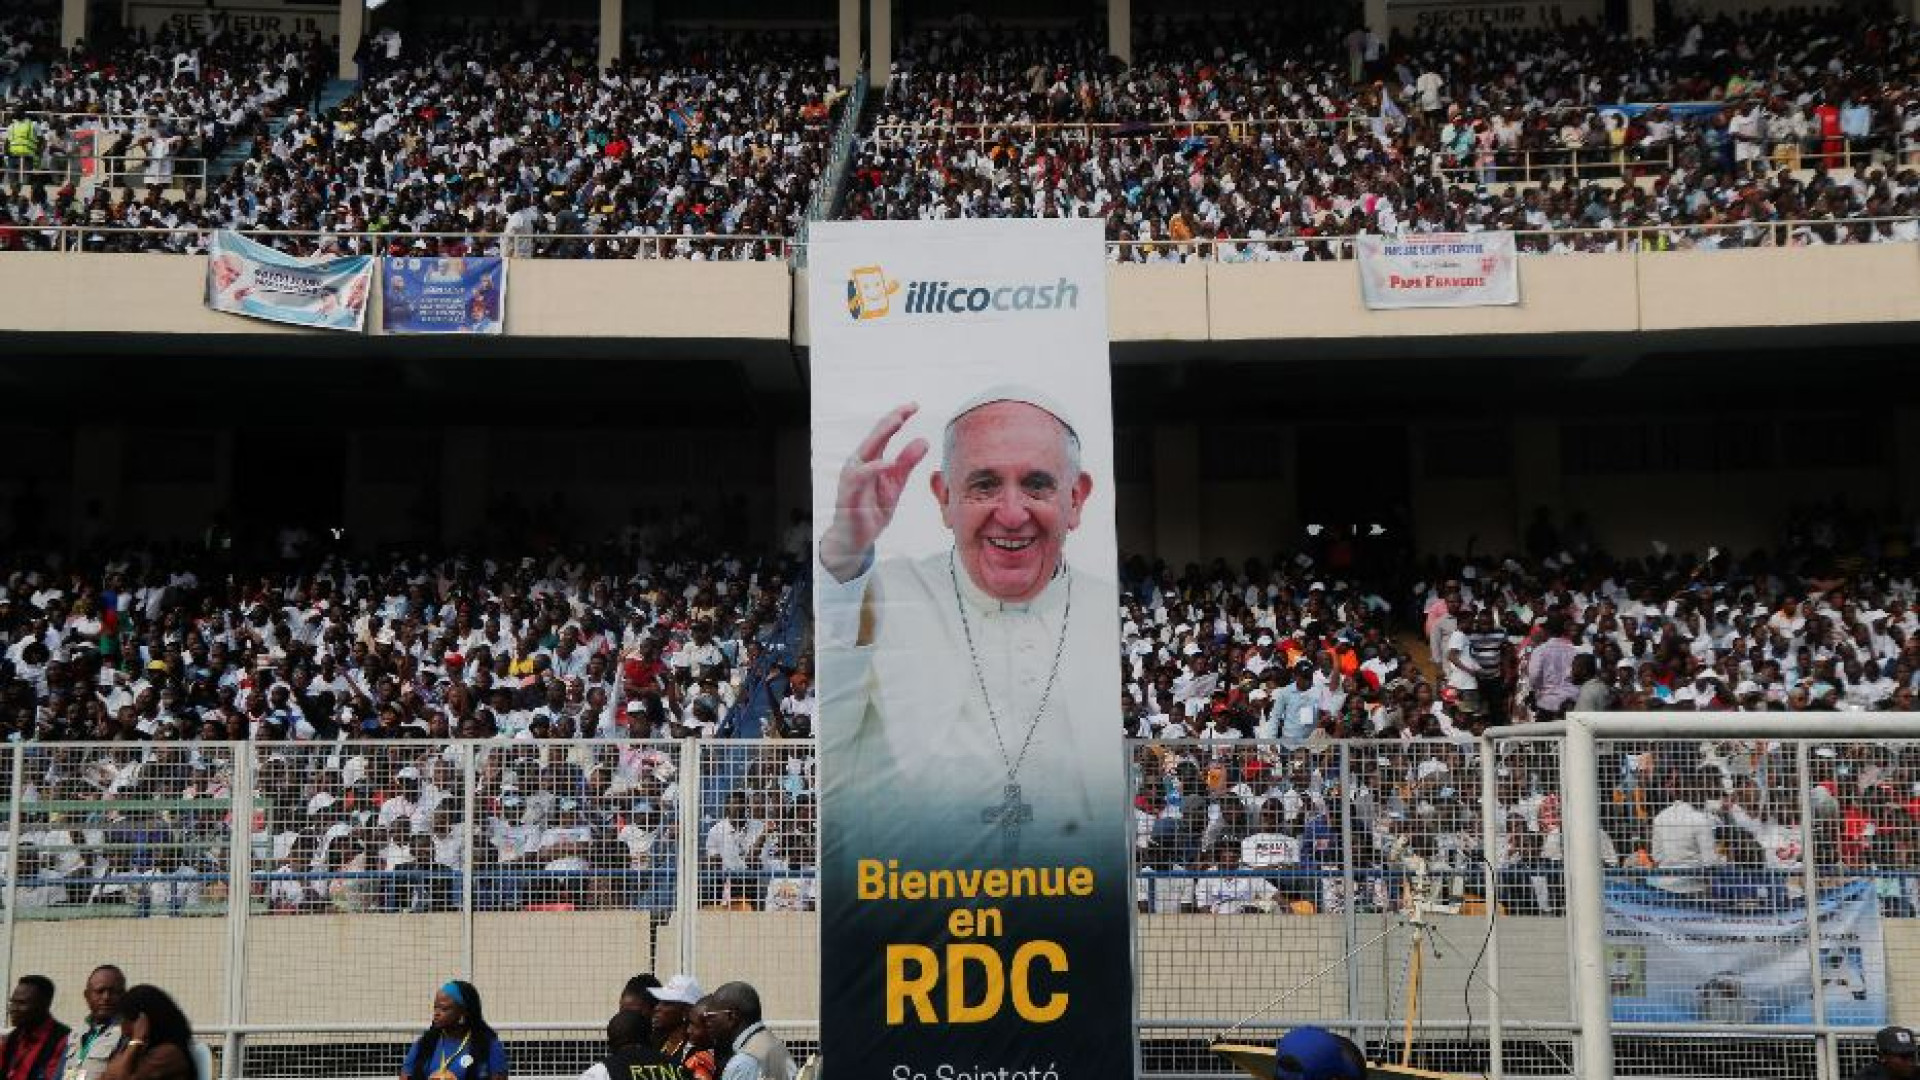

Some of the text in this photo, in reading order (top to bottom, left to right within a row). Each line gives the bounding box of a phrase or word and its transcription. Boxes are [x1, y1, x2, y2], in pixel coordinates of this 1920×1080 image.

[904, 277, 1079, 314] illicocash
[857, 859, 1094, 900] Bienvenue
[948, 906, 1003, 937] en
[886, 939, 1069, 1026] RDC
